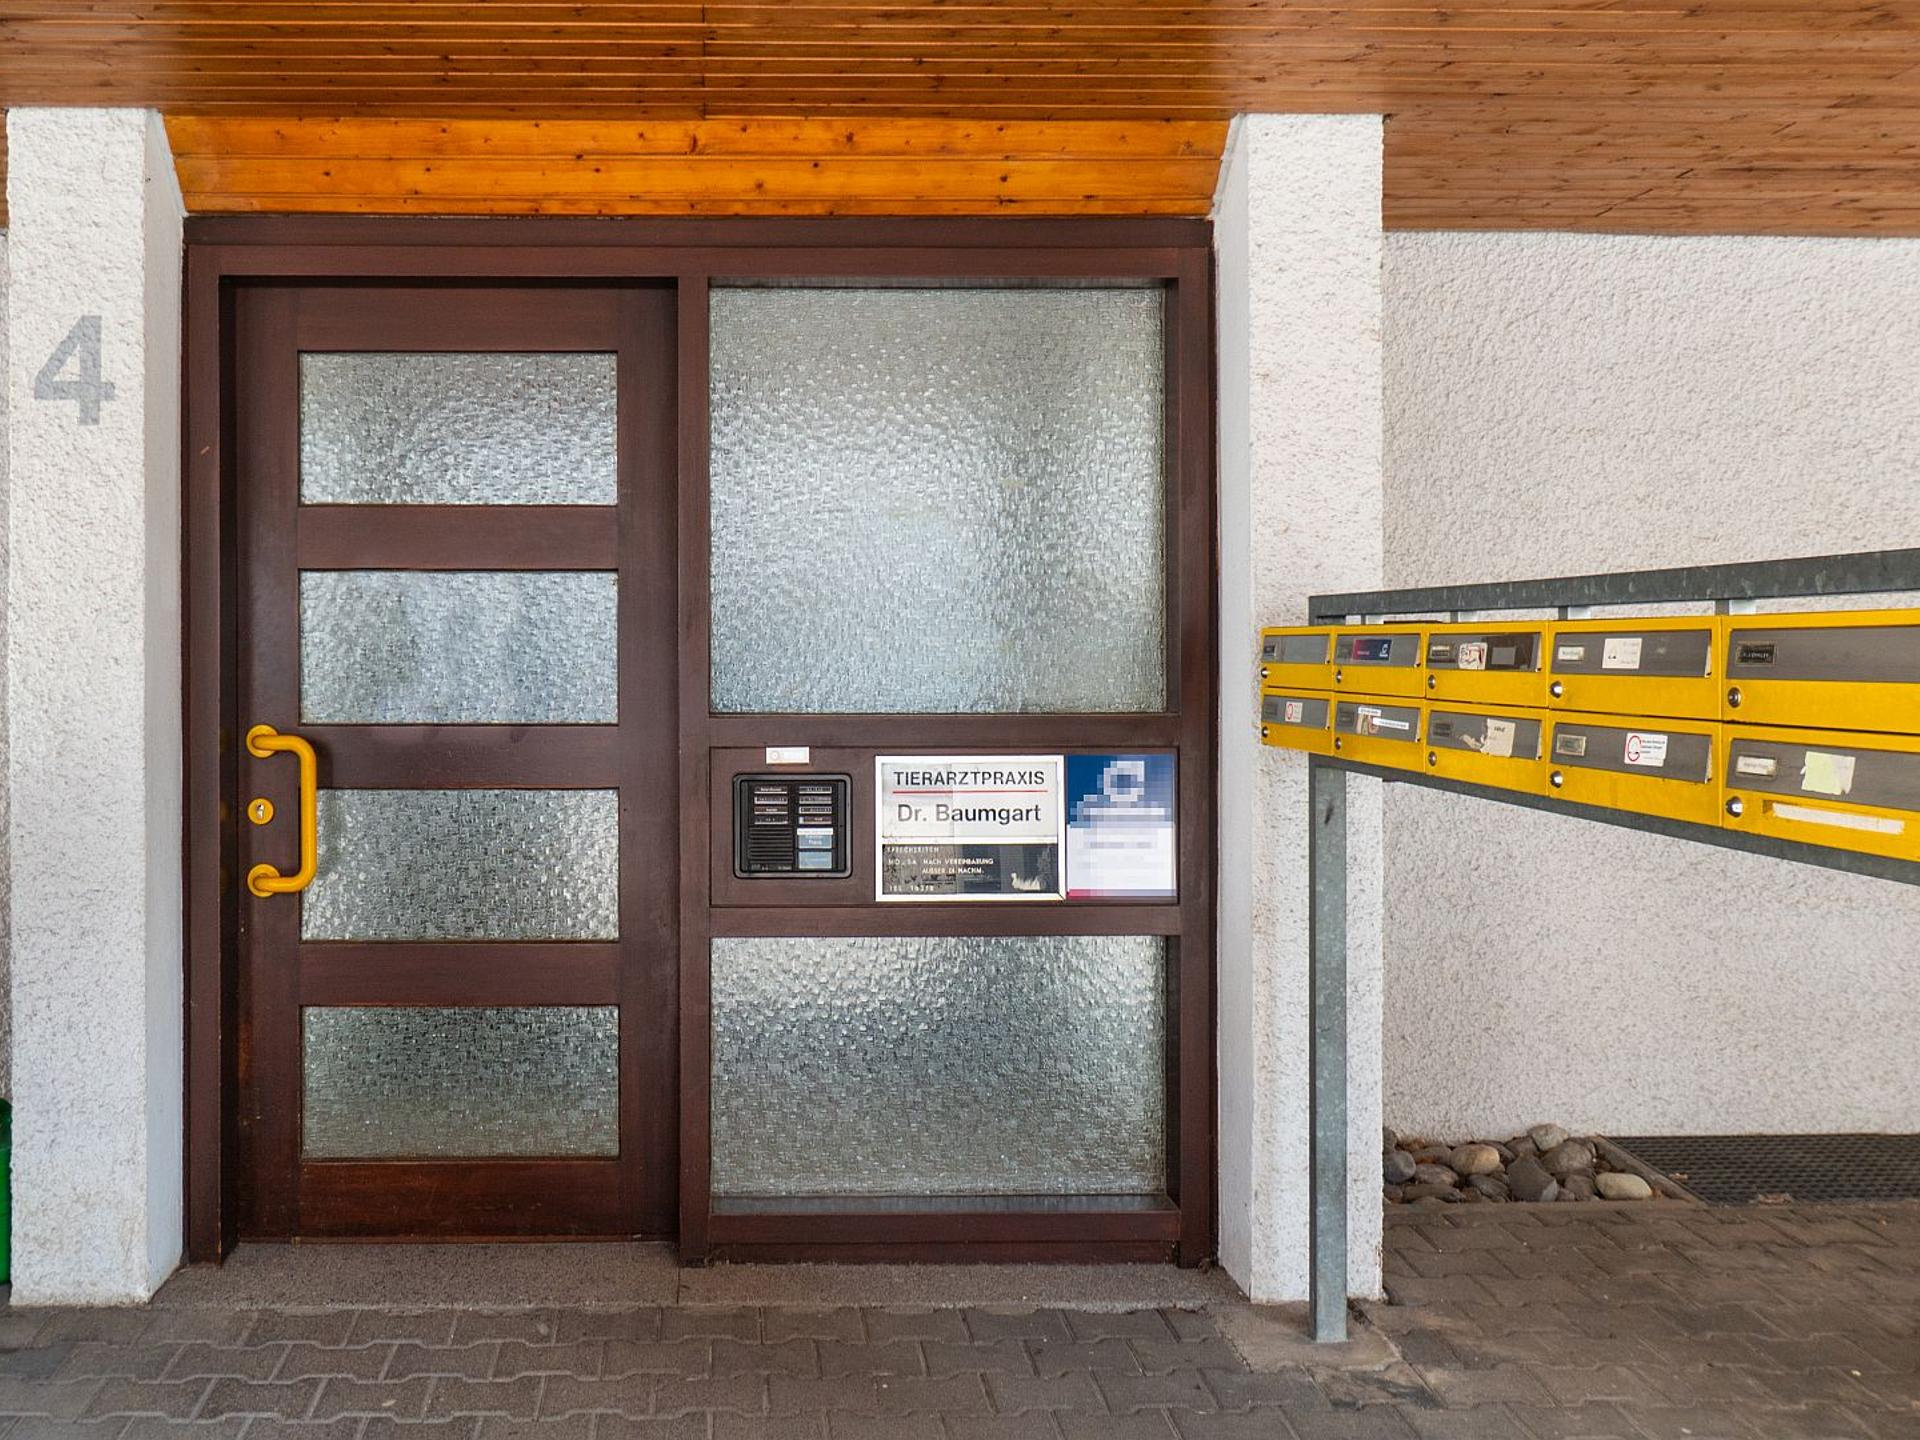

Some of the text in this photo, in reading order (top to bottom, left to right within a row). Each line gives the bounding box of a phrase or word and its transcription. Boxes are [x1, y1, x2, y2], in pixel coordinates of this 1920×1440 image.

[34, 315, 116, 425] 4
[893, 770, 1045, 786] TIERARZTPRAXIS
[897, 803, 1042, 825] Dr. Baumgart
